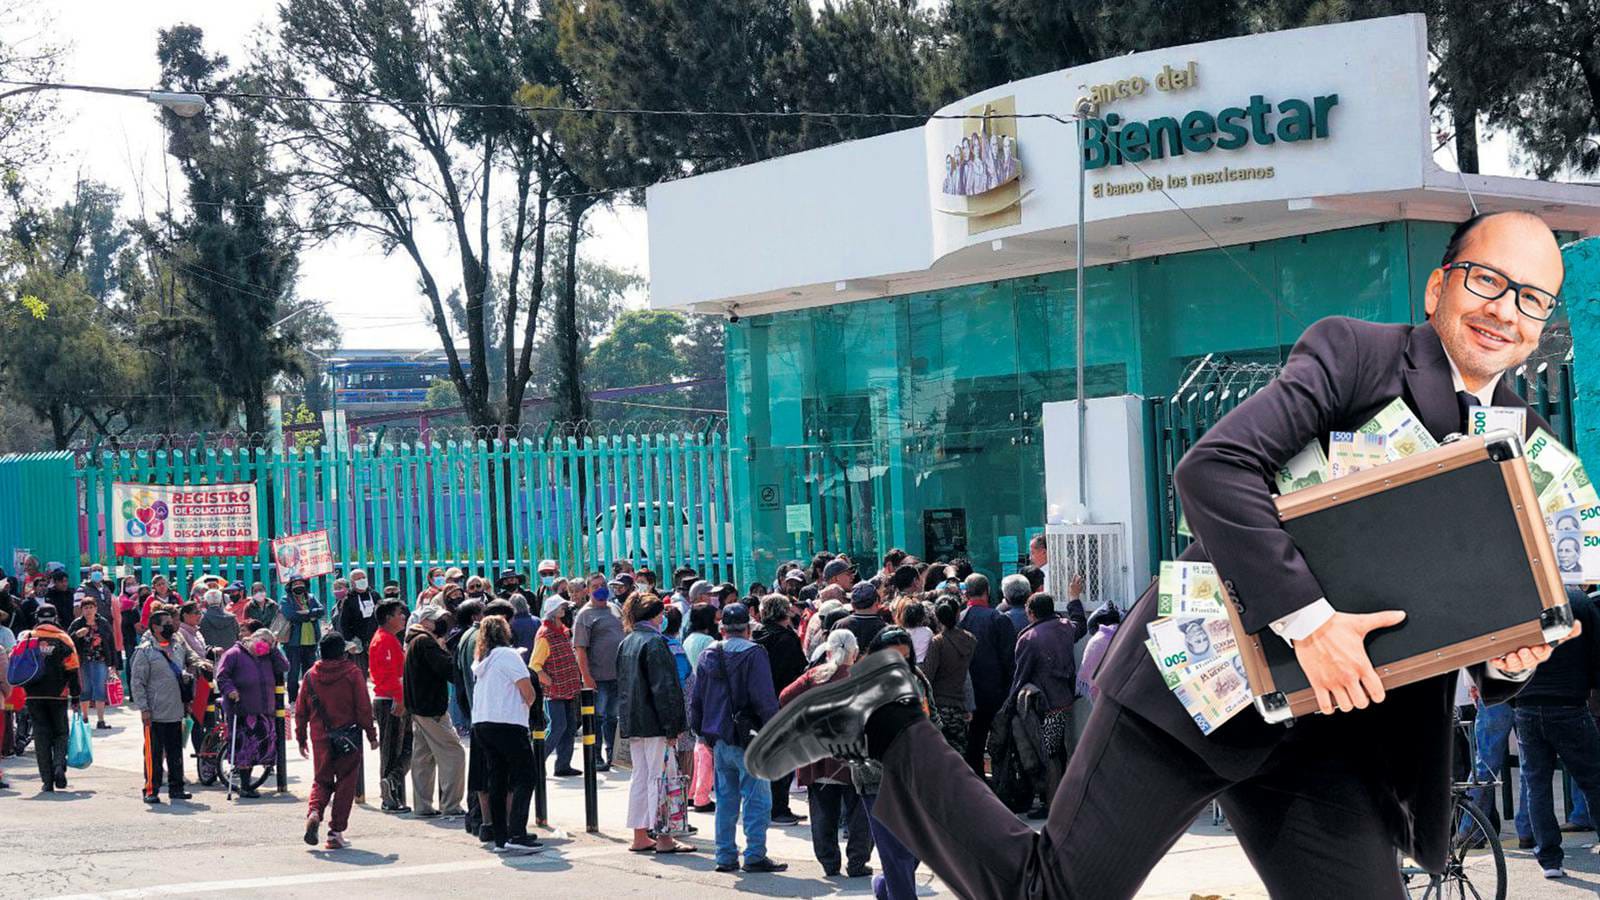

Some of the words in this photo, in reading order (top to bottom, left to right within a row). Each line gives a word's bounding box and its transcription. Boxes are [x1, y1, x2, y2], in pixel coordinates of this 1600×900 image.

[1155, 61, 1196, 91] del
[1077, 93, 1339, 170] Bienestar
[1092, 183, 1103, 198] El
[1106, 180, 1144, 195] banco
[1148, 177, 1163, 191] de
[1167, 174, 1187, 189] los
[1192, 166, 1275, 185] mexicanos
[1474, 411, 1486, 435] 500
[1335, 432, 1352, 441] 500
[1527, 437, 1547, 460] 200
[172, 491, 250, 504] REGISTRO
[175, 506, 188, 514] DE
[189, 505, 249, 514] SOLICITANTES
[174, 529, 252, 538] DISCAPACIDAD
[1164, 650, 1188, 668] 500
